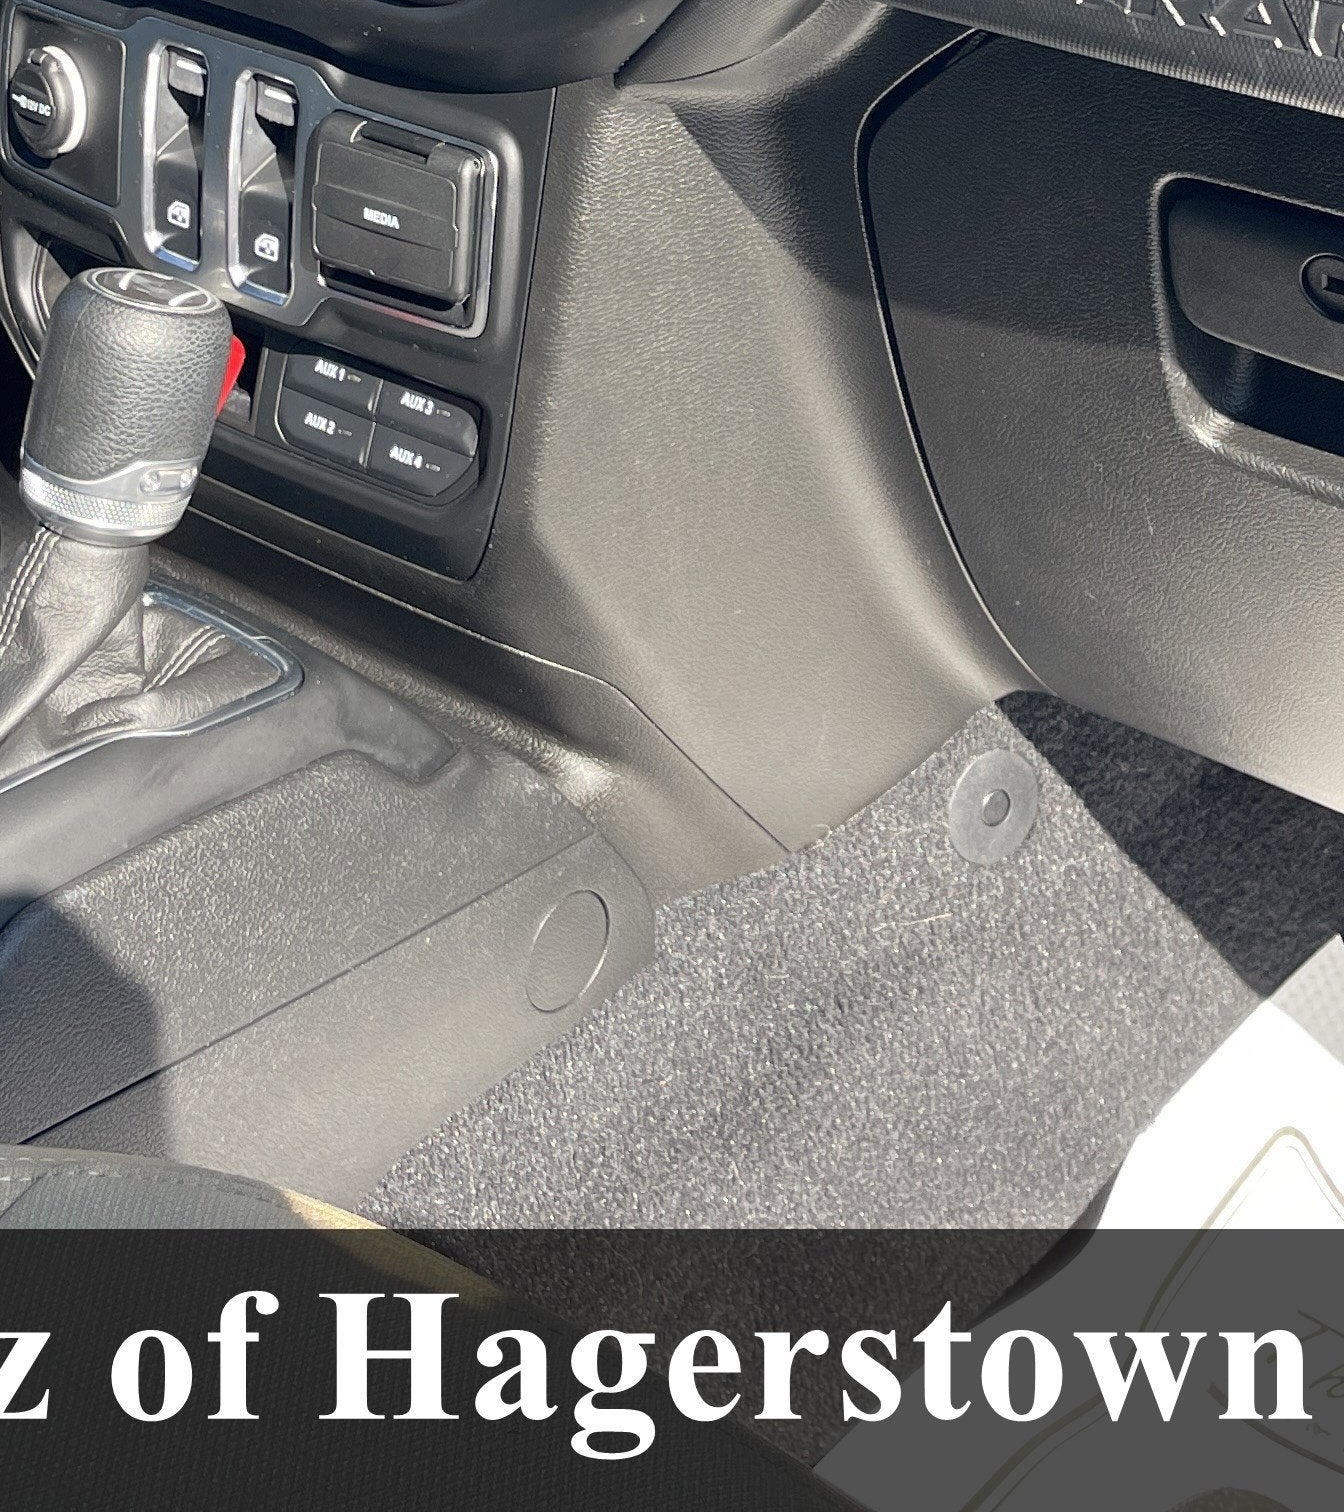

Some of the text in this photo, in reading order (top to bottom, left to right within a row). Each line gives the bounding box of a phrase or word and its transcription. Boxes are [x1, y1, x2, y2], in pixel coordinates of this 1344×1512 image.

[38, 102, 51, 117] DC
[363, 206, 400, 230] MEDIA
[315, 358, 346, 382] AUX 1
[400, 391, 435, 416] AUX 3
[304, 411, 337, 435] AUX 2
[389, 444, 423, 469] AUX 4
